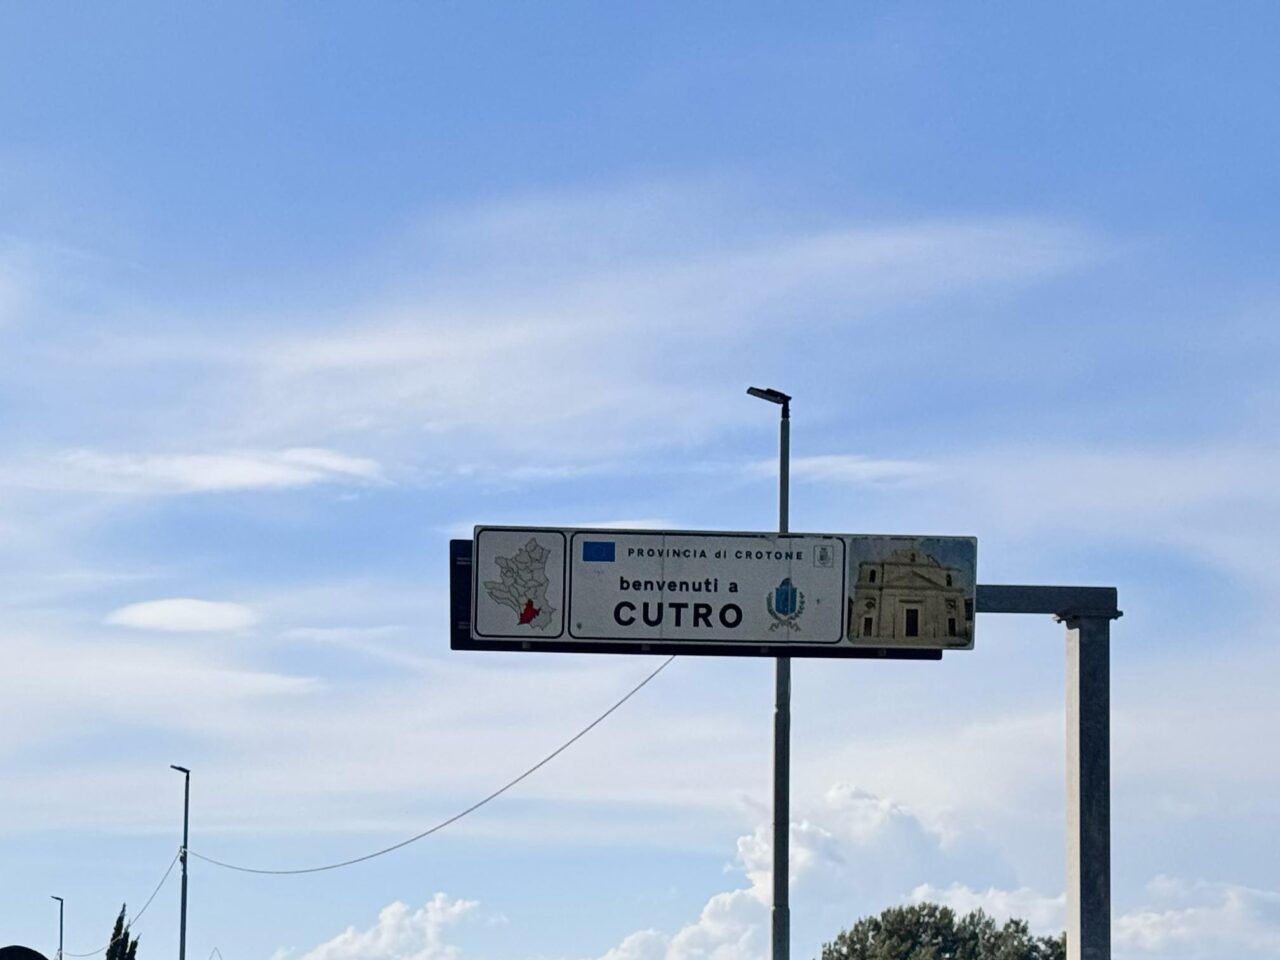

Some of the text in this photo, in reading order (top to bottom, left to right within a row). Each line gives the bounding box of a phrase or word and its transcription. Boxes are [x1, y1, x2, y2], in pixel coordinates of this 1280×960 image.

[628, 547, 803, 561] PROVINCIA di CROTONE
[620, 576, 739, 594] benvenuti a
[613, 601, 744, 629] CUTRO
